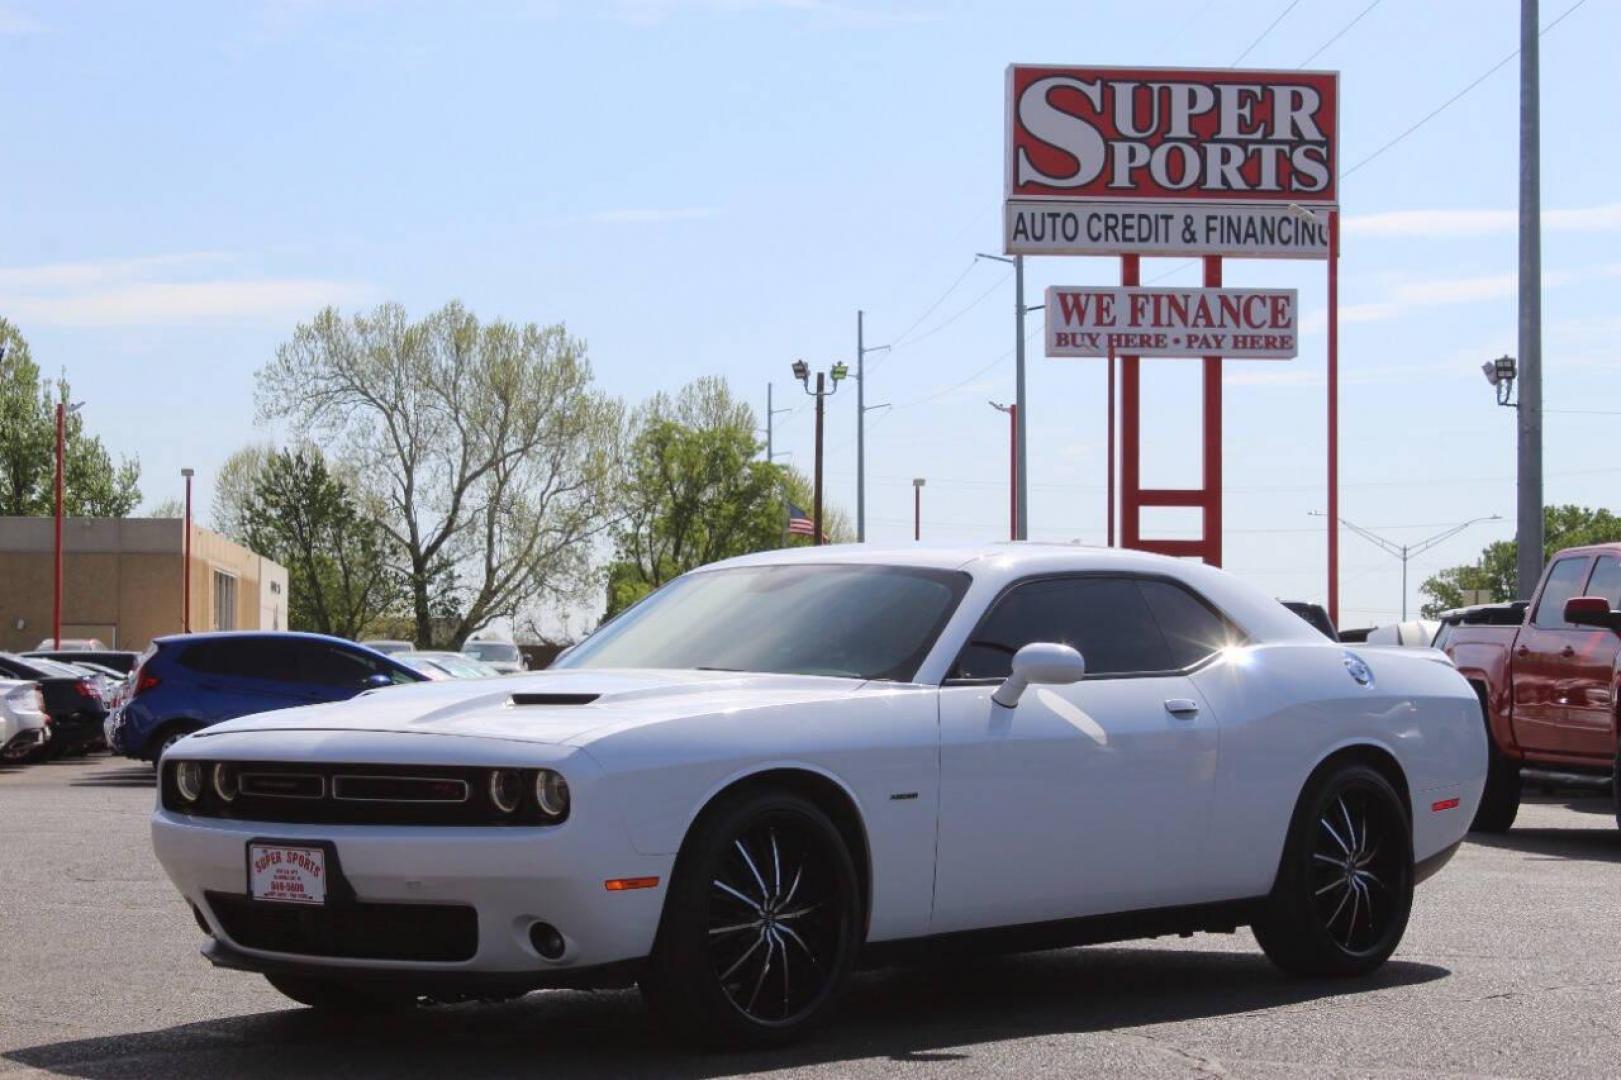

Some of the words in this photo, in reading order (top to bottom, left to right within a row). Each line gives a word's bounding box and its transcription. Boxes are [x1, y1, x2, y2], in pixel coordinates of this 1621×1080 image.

[1019, 76, 1328, 188] SUPER
[1013, 212, 1079, 242] AUTO
[1087, 213, 1174, 244] CREDIT
[1182, 214, 1197, 244] &
[1056, 292, 1117, 327] WE
[1127, 293, 1293, 329] FINANCE
[1055, 332, 1100, 349] BUY
[1108, 333, 1168, 349] HERE
[1186, 334, 1226, 350] PAY
[1232, 335, 1294, 351] HERE
[255, 851, 281, 873] SUPER
[287, 851, 321, 877] SPORTS
